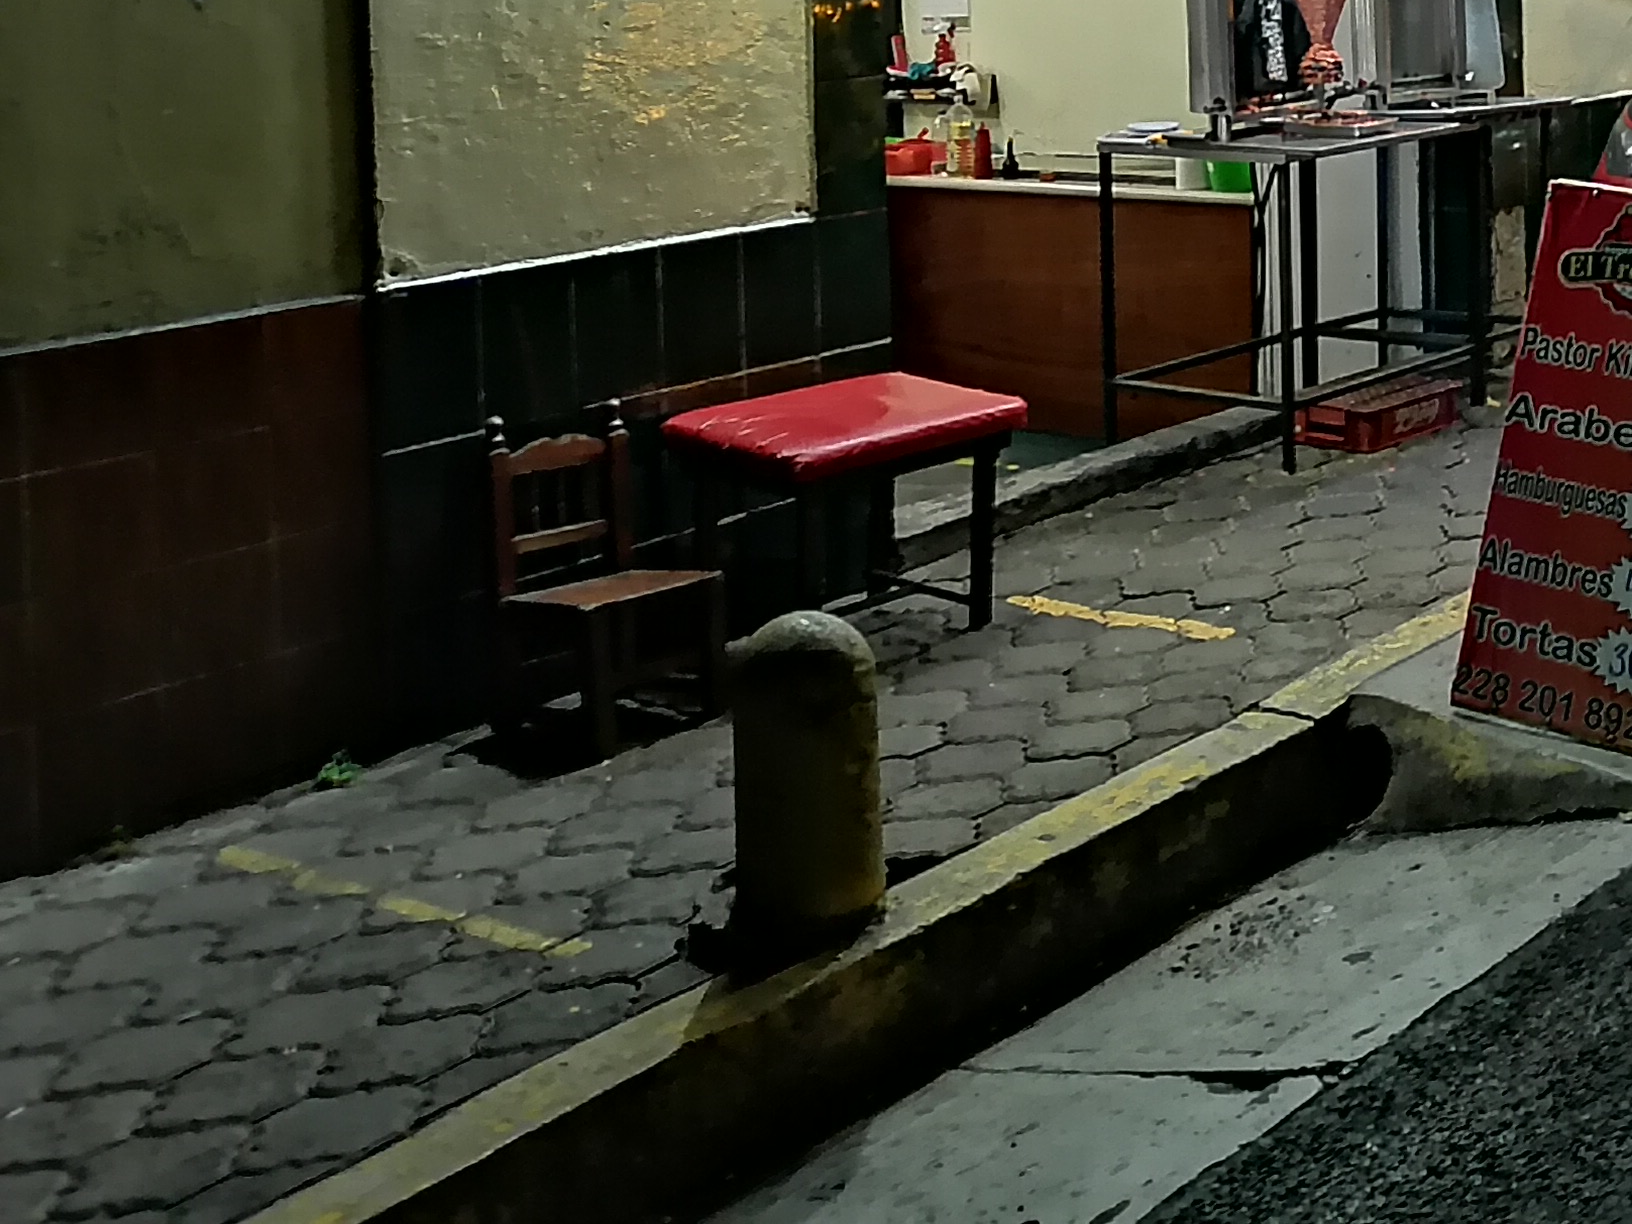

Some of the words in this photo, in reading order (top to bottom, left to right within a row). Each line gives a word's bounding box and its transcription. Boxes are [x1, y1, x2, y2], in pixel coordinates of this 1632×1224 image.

[1568, 255, 1594, 277] El
[1520, 327, 1600, 372] Pastor
[1494, 464, 1628, 519] Hamburguesas
[1478, 539, 1612, 599] Alambres
[1471, 606, 1599, 668] Tortas
[1452, 663, 1510, 712] 228
[1518, 679, 1574, 722] 201
